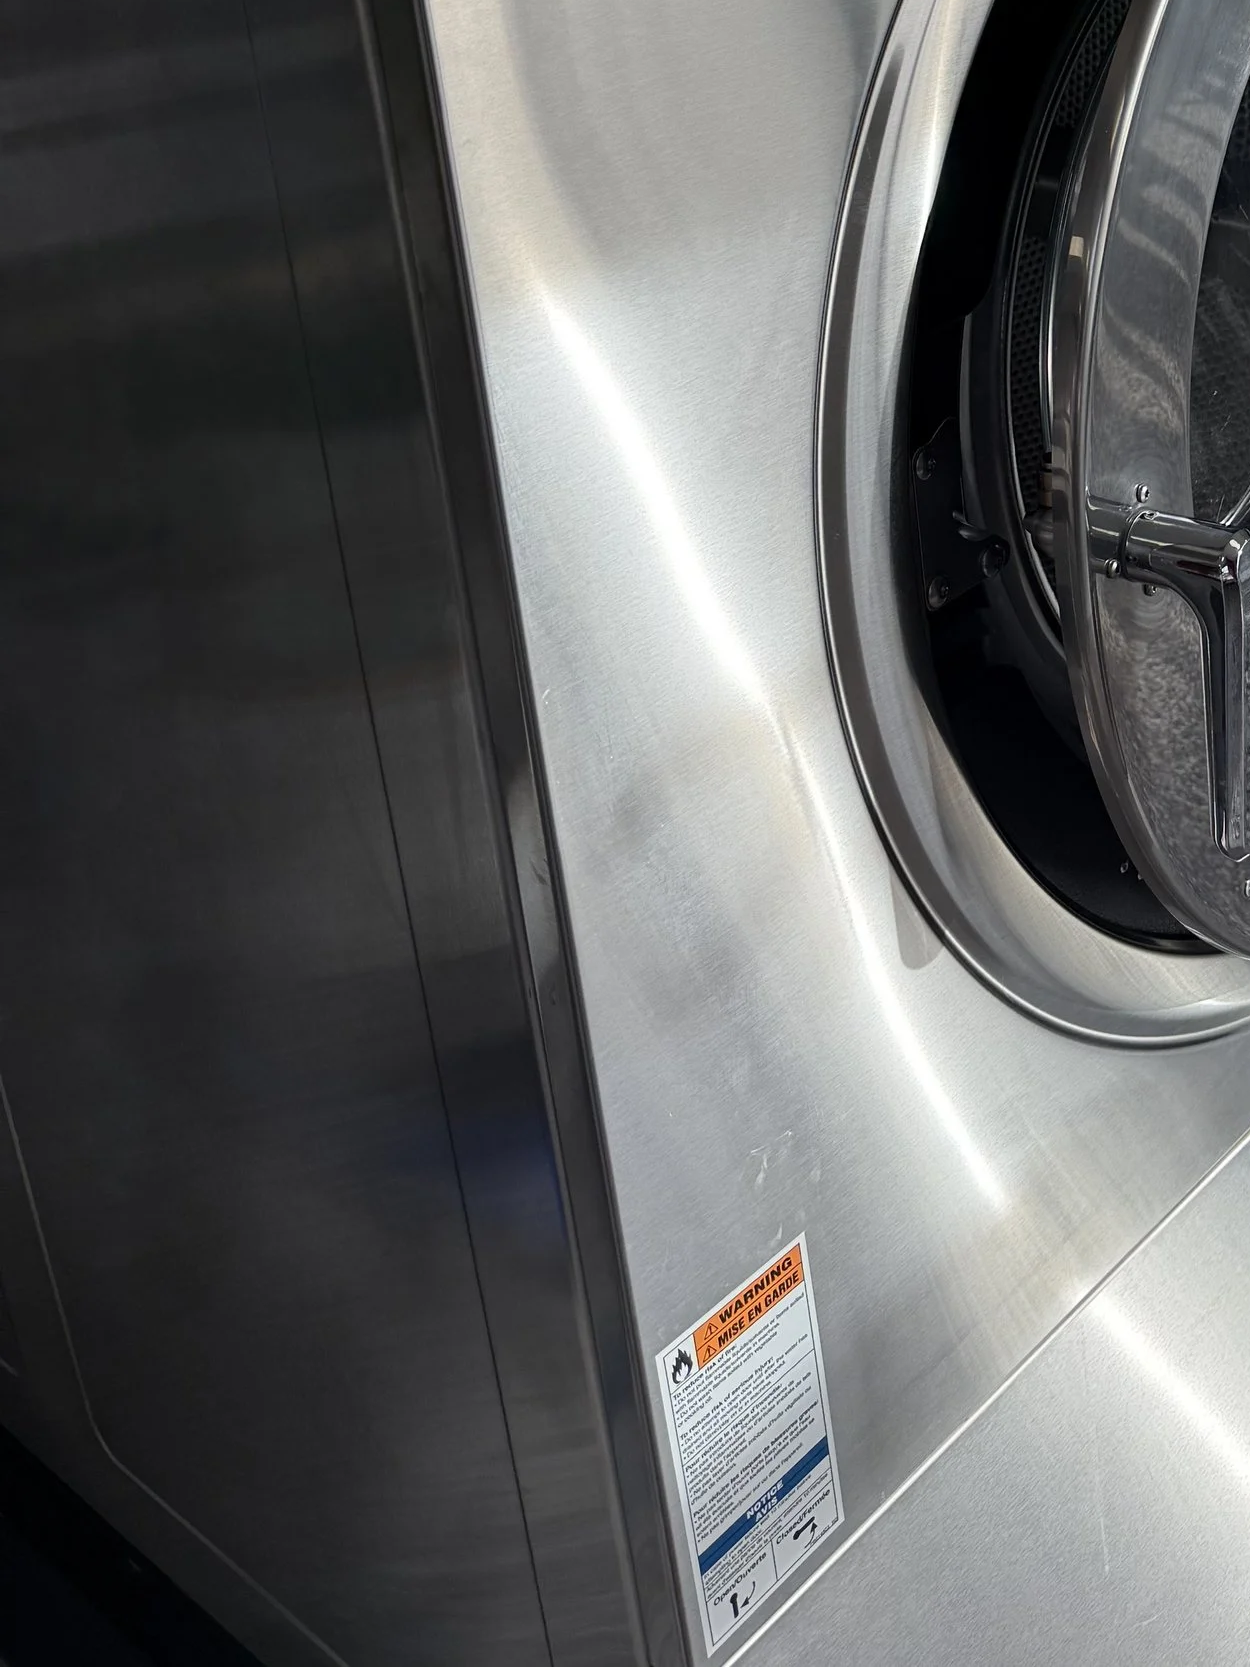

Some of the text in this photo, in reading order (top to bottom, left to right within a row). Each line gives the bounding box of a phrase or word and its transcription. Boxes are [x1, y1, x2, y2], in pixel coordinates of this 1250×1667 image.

[717, 1269, 799, 1349] MISE EN GARDE
[718, 1254, 792, 1326] WARNING
[745, 1477, 784, 1521] NOTICE
[754, 1493, 778, 1523] AVIS
[775, 1485, 830, 1546] Closed/Fermée
[712, 1548, 767, 1609] Open/Ouverte
